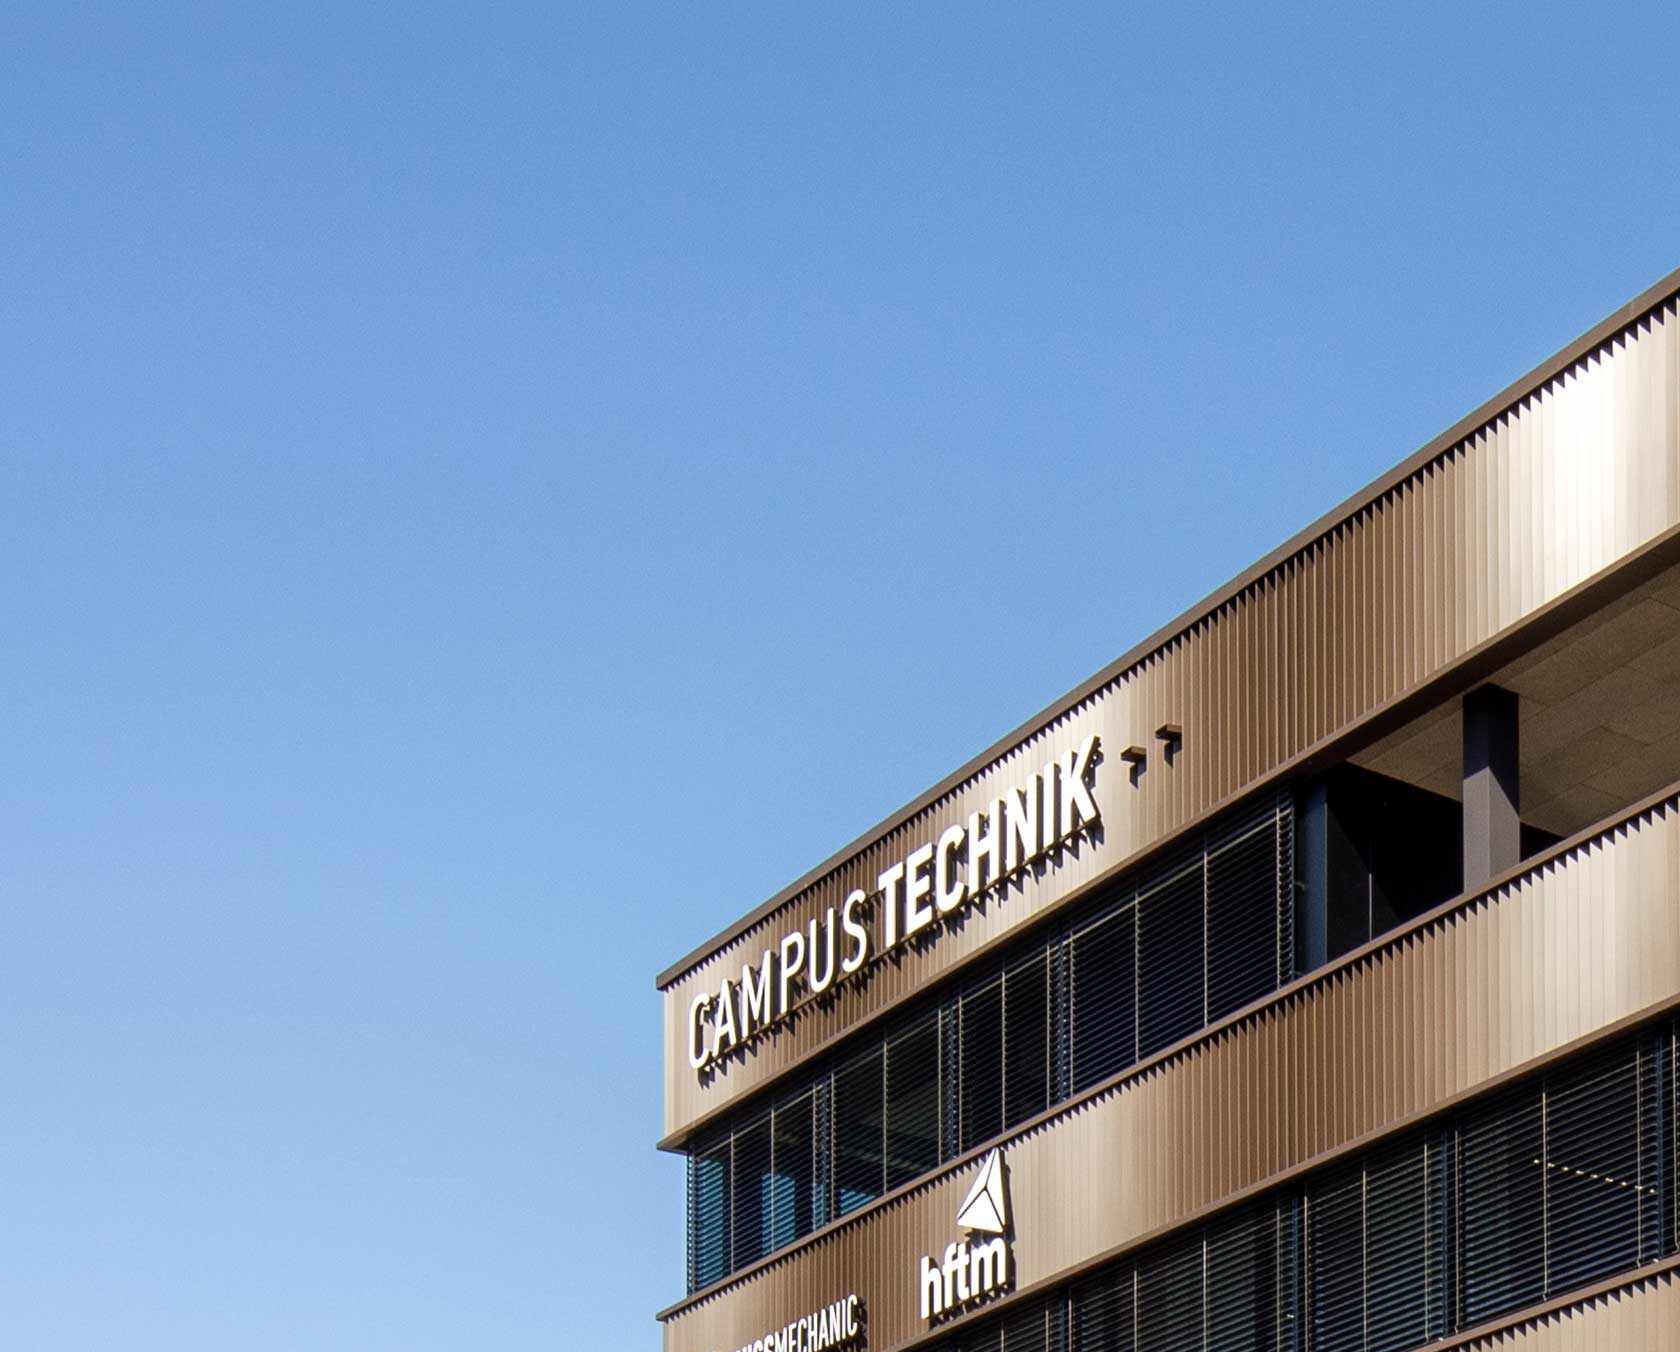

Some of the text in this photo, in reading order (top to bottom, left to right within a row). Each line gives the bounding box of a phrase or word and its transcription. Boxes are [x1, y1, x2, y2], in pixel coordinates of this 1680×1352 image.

[689, 735, 1099, 1069] CAMPUS TECHNIK
[921, 1237, 1007, 1319] hftm
